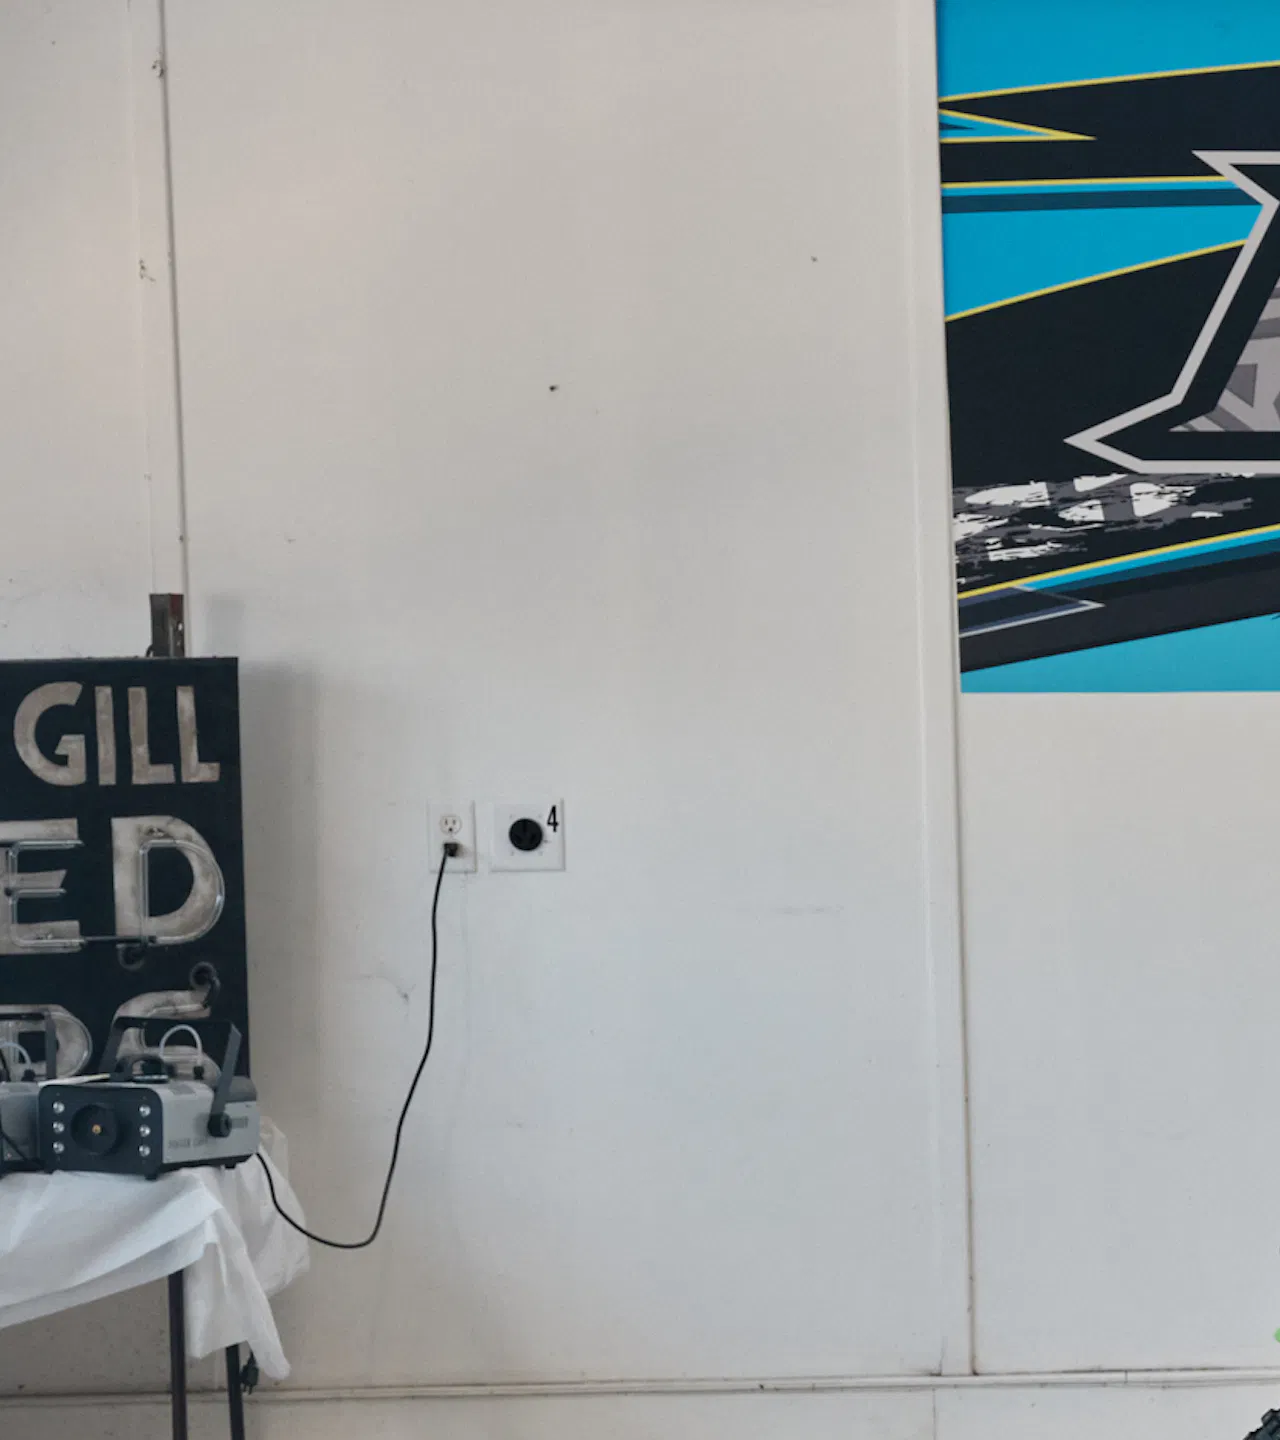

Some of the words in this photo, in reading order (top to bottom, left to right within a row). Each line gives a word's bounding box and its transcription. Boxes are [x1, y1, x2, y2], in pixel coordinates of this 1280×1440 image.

[13, 681, 221, 787] GILL
[546, 804, 560, 833] 4
[0, 814, 226, 955] ED
